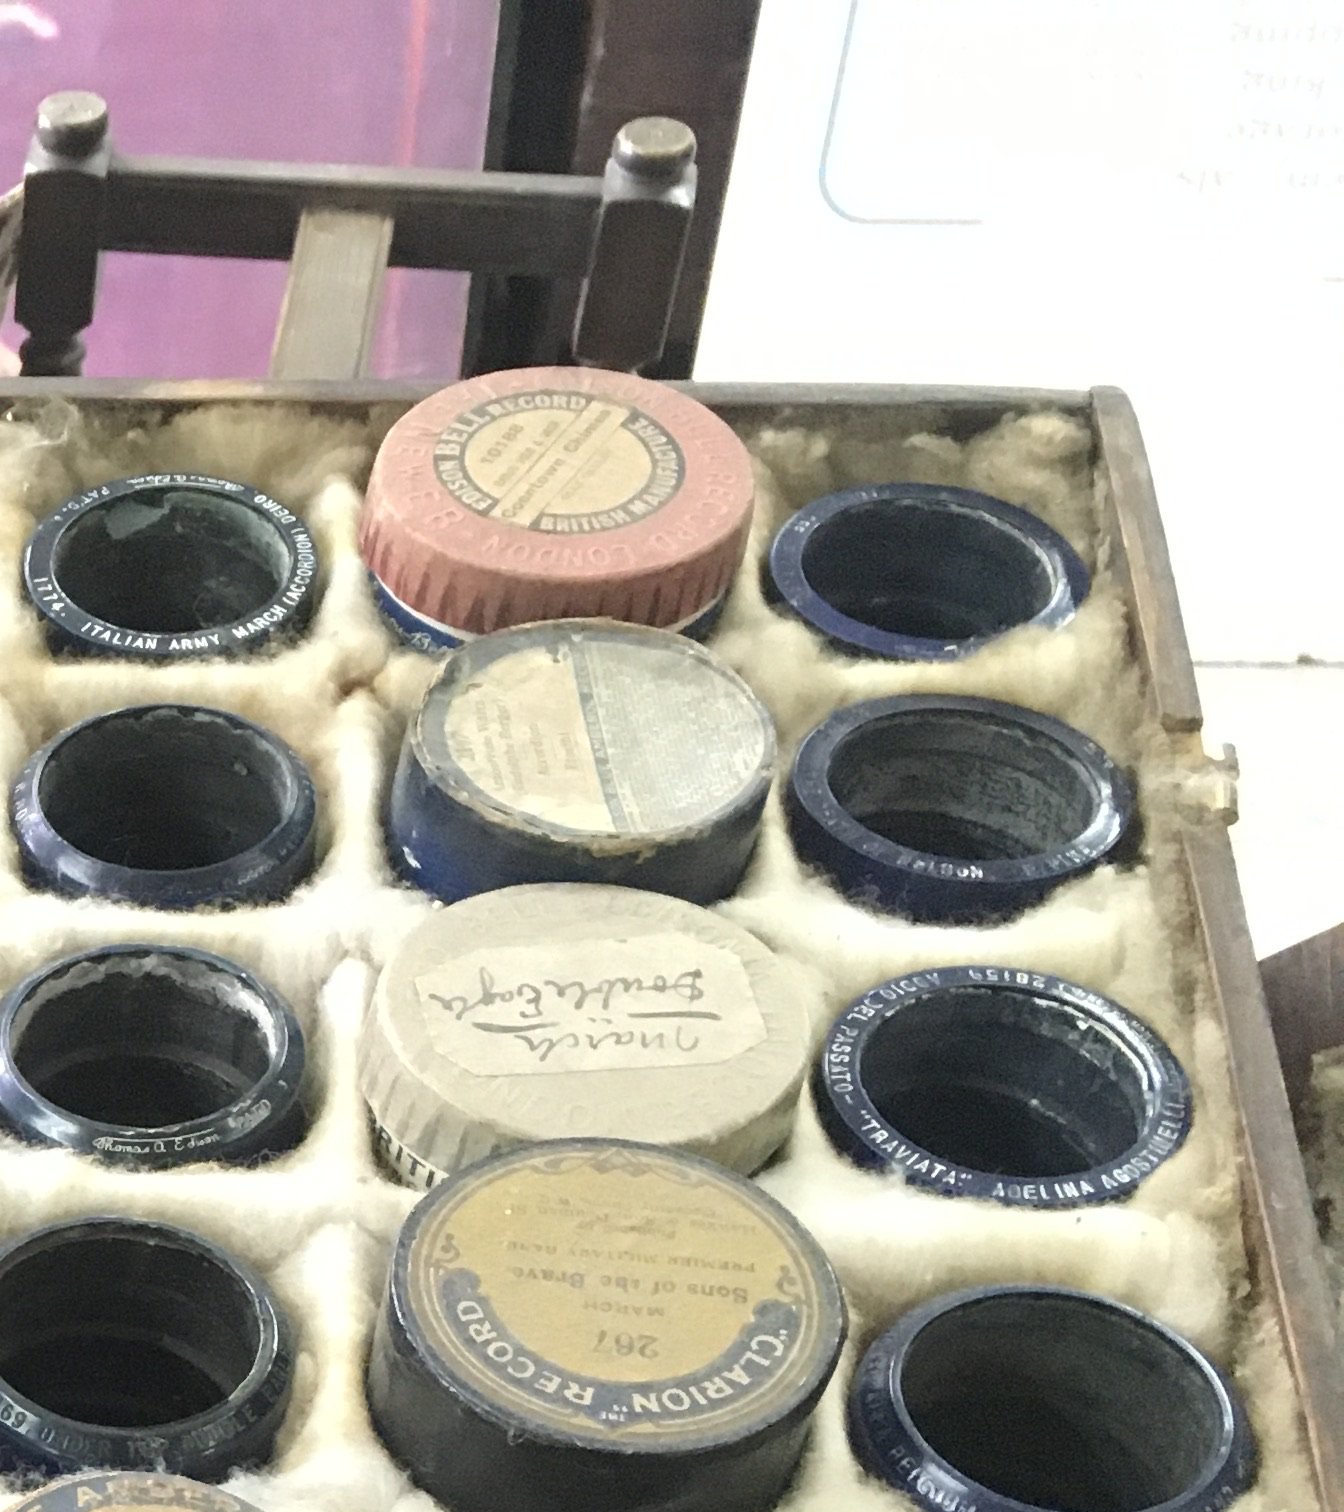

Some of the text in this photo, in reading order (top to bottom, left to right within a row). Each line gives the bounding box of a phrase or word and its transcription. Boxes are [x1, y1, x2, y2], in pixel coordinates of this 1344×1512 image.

[496, 393, 588, 417] RECORD
[436, 409, 490, 457] BELL
[437, 453, 492, 512] EDISON
[539, 512, 633, 532] BRITISH
[630, 416, 682, 515] MANUFACTURE
[80, 621, 158, 650] ITALIAN
[168, 633, 222, 650] ARMY
[232, 604, 288, 640] MARCH
[992, 1179, 1094, 1200] ADELINA
[565, 1245, 658, 1264] MILITARY
[666, 1255, 756, 1273] PREMIER
[598, 1274, 749, 1304] Sons of the
[581, 1299, 665, 1317] MARCH
[457, 1299, 596, 1406] RECORD
[590, 1328, 660, 1359] 267
